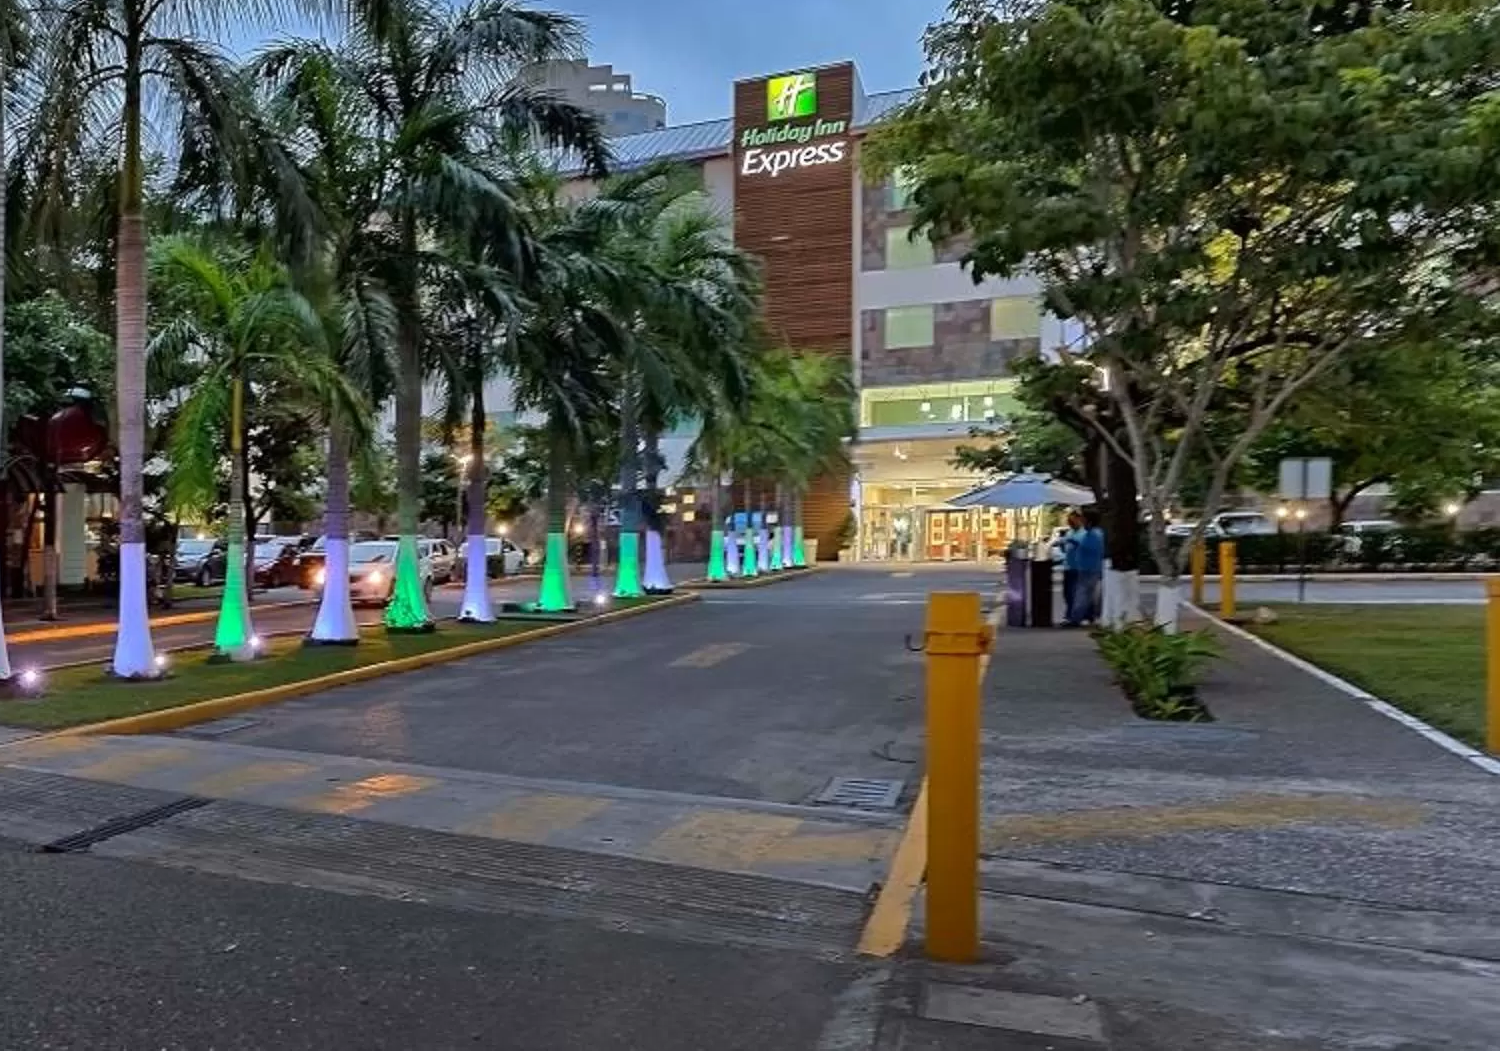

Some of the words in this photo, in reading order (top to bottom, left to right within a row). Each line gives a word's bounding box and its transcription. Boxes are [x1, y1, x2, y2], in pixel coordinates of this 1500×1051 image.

[741, 123, 813, 147] Holiday
[814, 118, 845, 136] Inn
[741, 141, 845, 177] Express
